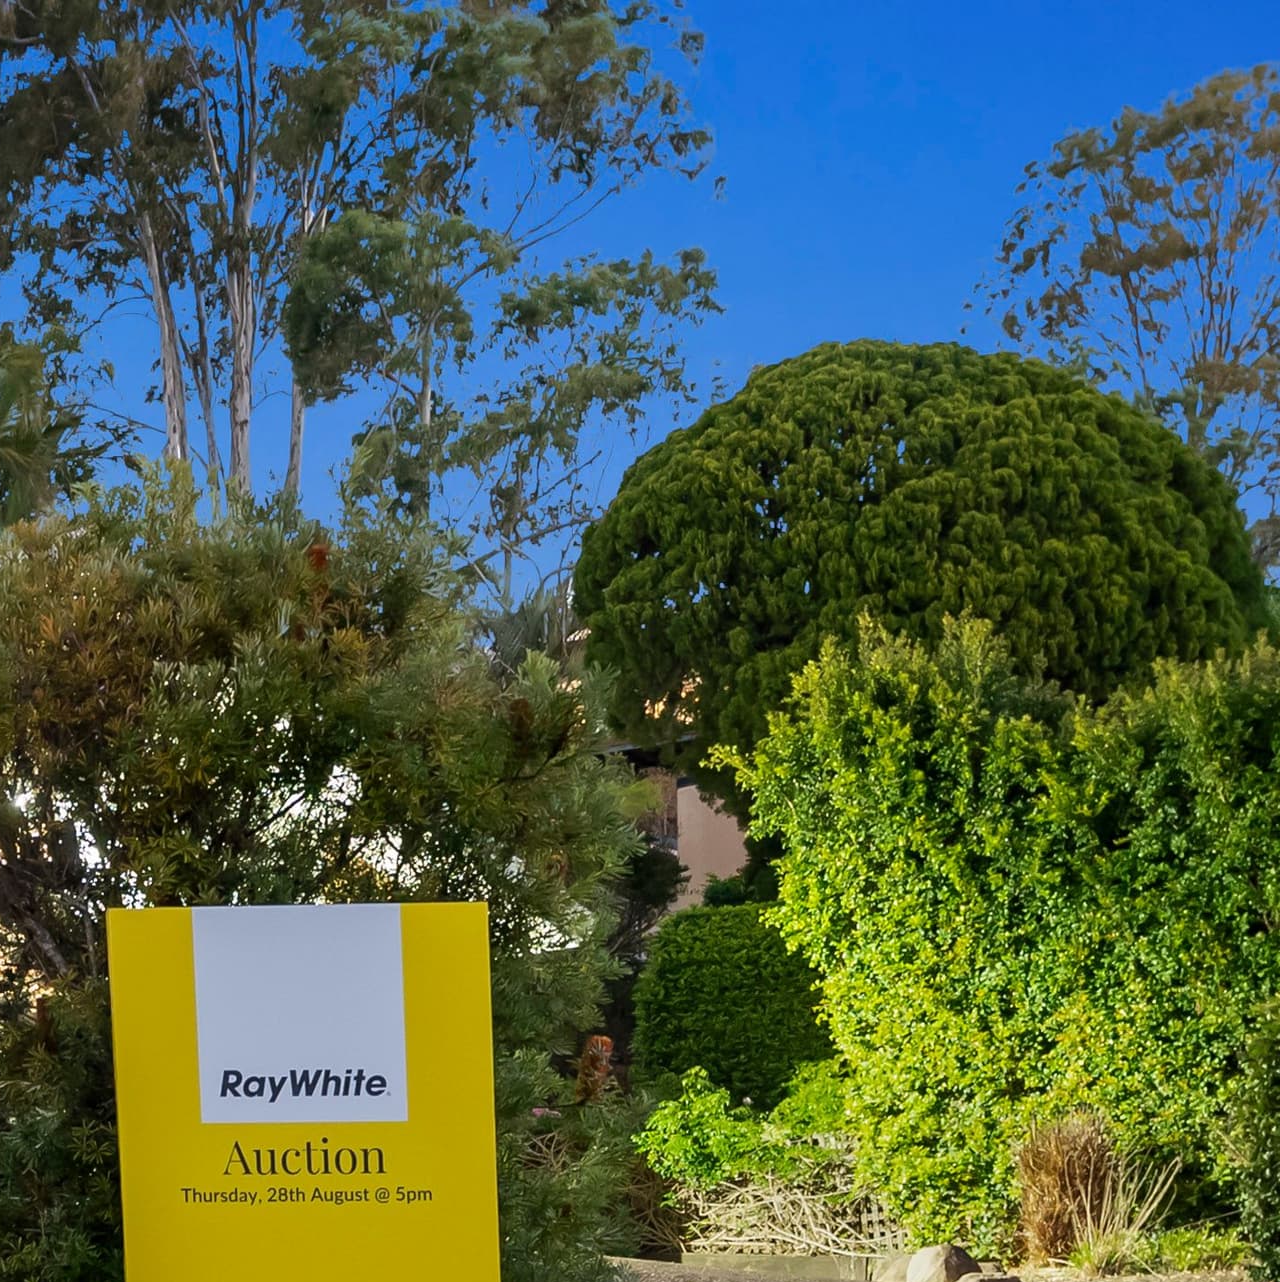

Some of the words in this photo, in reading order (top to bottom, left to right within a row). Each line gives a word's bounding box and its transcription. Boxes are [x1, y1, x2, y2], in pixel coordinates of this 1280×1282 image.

[224, 1137, 386, 1175] Auction
[181, 1187, 262, 1205] Thursday,
[267, 1187, 305, 1202] 28th
[311, 1187, 369, 1205] August
[375, 1187, 390, 1203] @
[396, 1186, 432, 1204] 5pm
